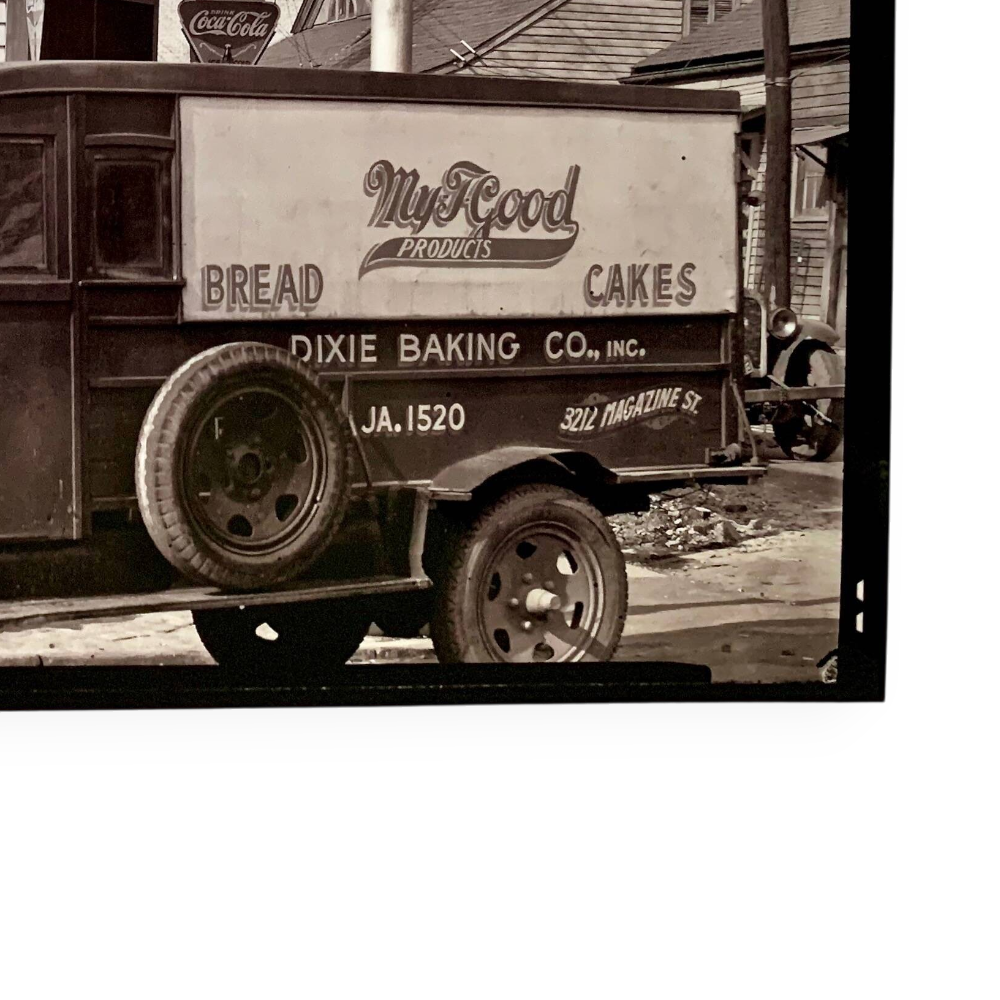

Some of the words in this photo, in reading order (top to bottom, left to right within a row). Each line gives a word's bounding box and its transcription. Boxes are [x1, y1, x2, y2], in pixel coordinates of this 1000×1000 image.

[189, 9, 273, 37] Coca-Cola
[396, 238, 492, 259] PRODUCTS
[202, 263, 324, 309] BREAD
[585, 262, 698, 309] CAKES
[290, 333, 378, 364] DIXIE
[399, 331, 521, 363] BAKING
[606, 338, 647, 359] INC.
[560, 405, 599, 432] 3212
[600, 387, 683, 428] MAGAZINE
